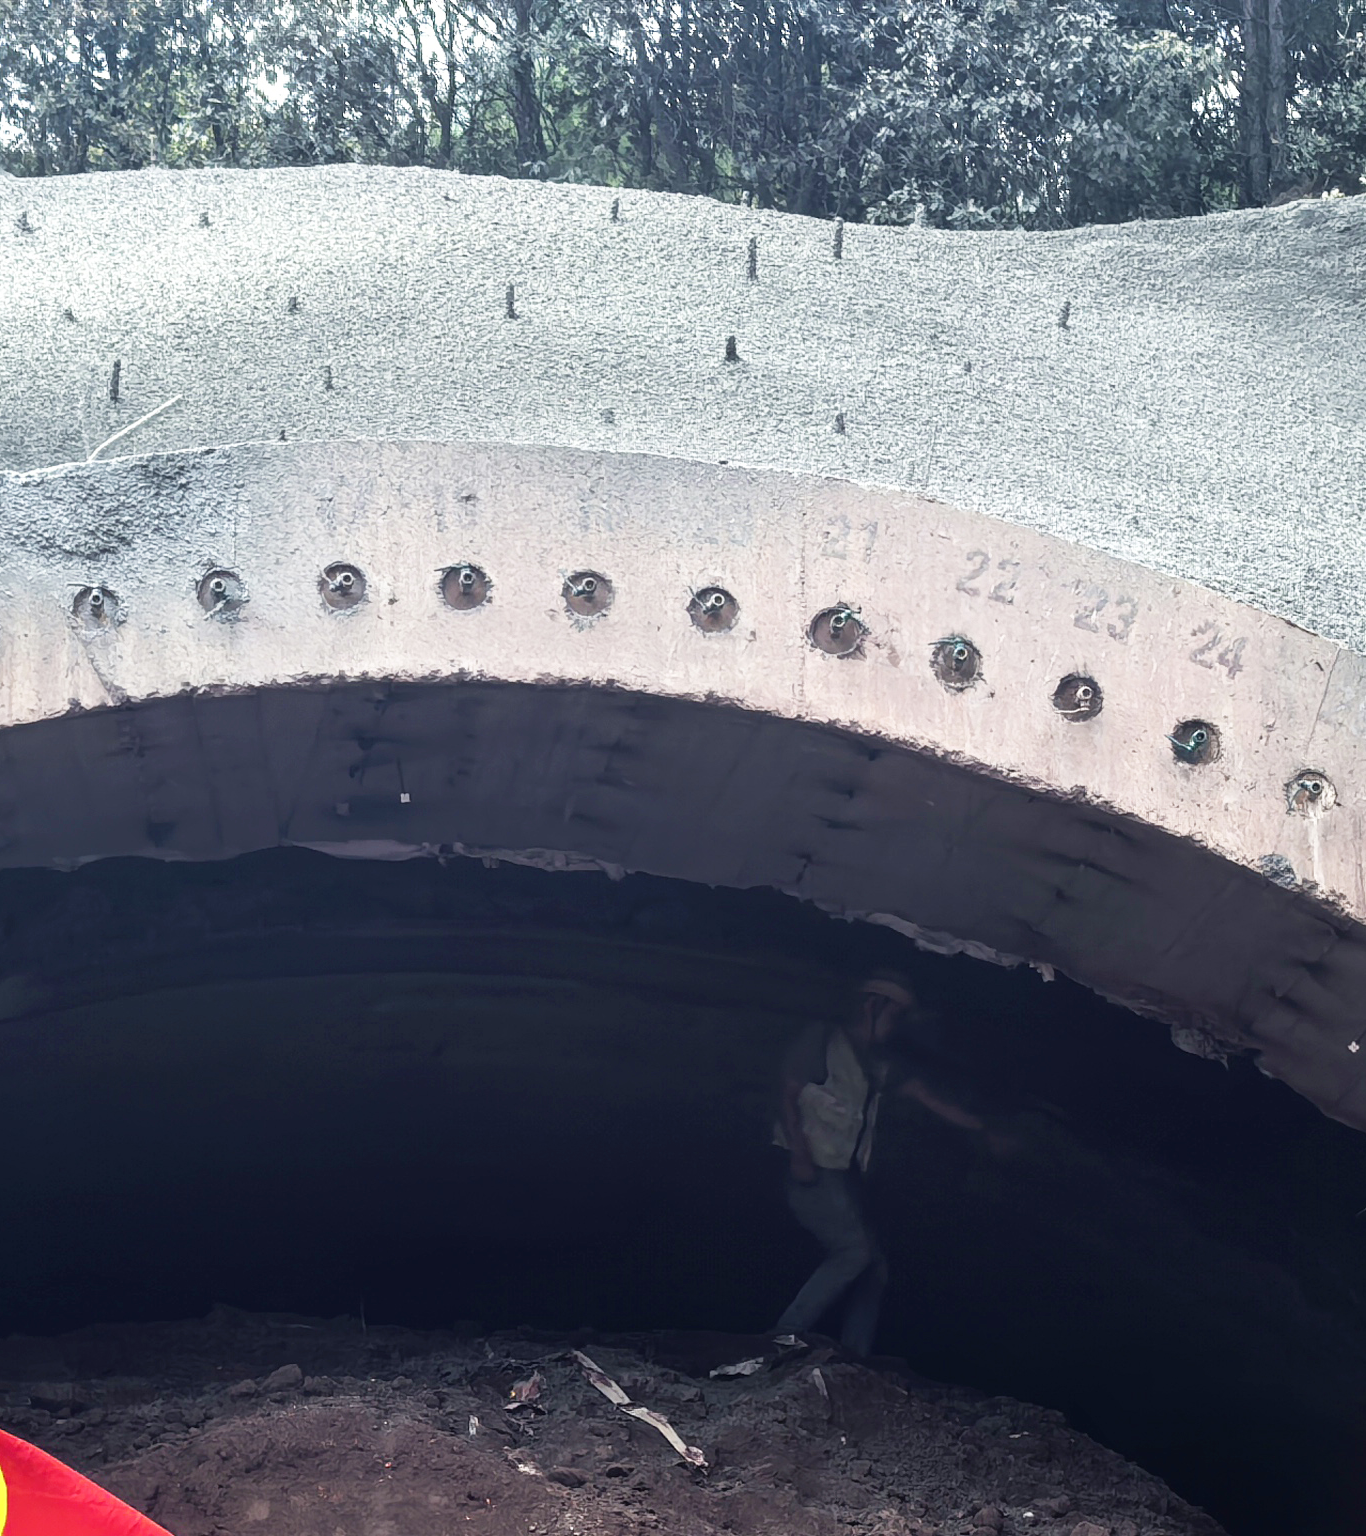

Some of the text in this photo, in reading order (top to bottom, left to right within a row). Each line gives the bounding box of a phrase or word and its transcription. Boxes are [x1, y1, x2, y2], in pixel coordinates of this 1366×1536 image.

[954, 548, 1021, 606] 22
[1072, 577, 1139, 642] 23
[1188, 618, 1248, 681] 24
